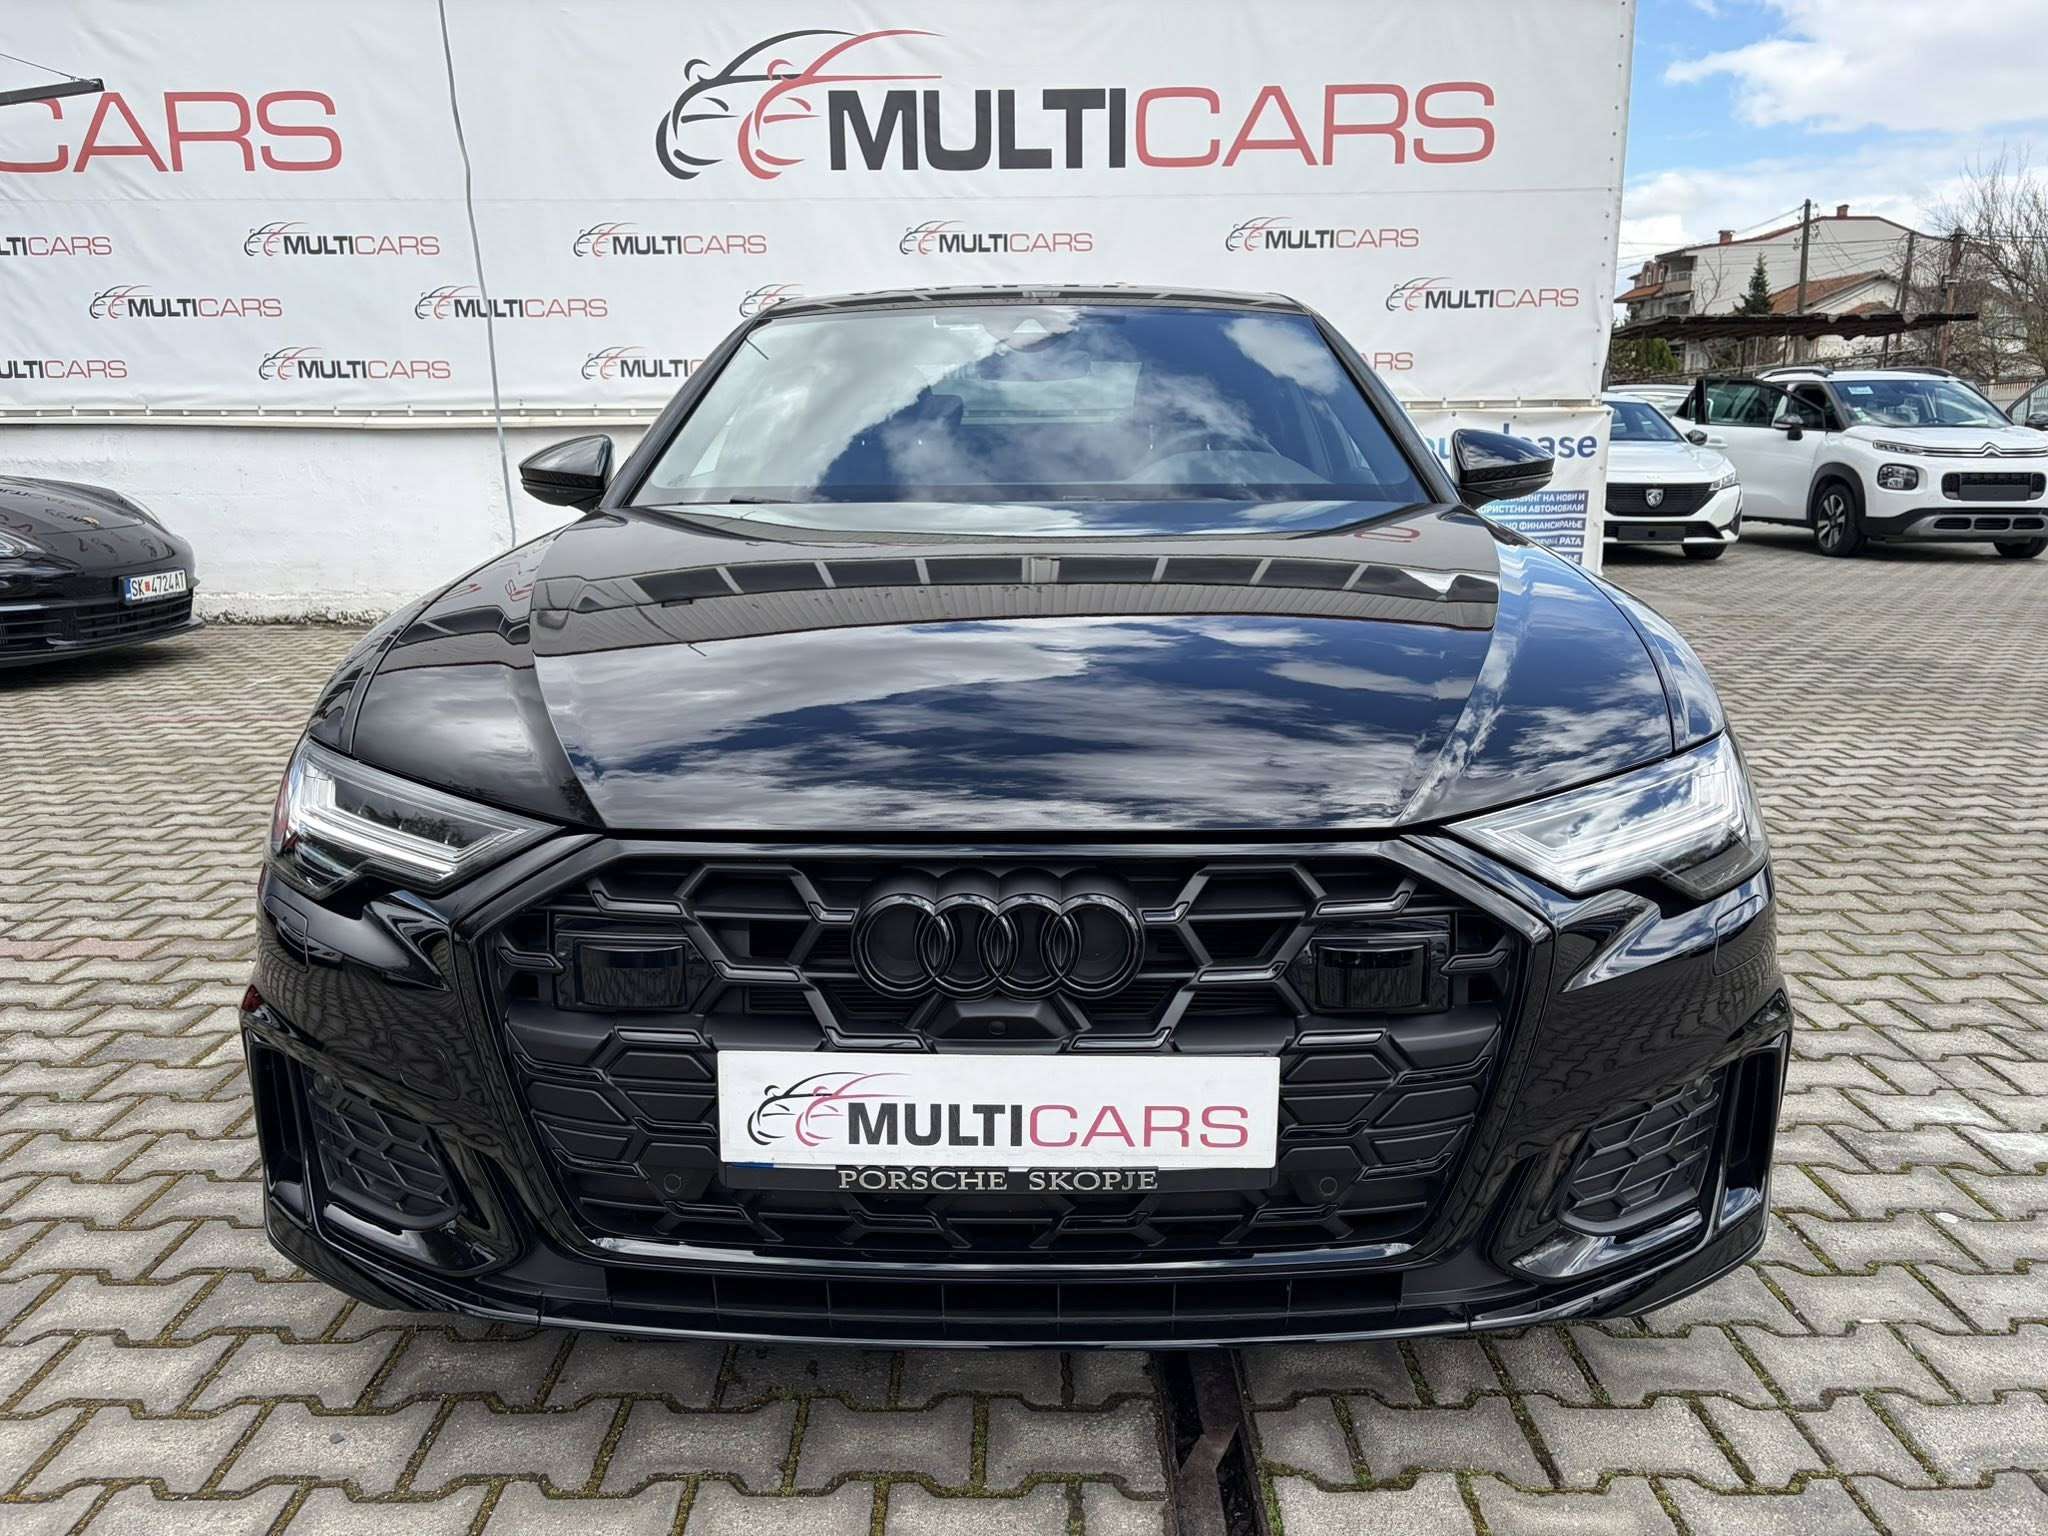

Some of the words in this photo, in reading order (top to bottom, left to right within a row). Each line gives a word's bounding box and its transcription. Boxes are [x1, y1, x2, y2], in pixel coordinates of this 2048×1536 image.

[828, 81, 1496, 172] MULTICARS
[283, 235, 440, 256] MULTICARS
[612, 234, 767, 256] MULTICARS
[938, 232, 1093, 253] MULTICARS
[1264, 229, 1419, 249] MULTICARS
[127, 298, 283, 318] MULTICARS
[453, 298, 608, 318] MULTICARS
[1424, 288, 1579, 309] MULTICARS
[297, 359, 451, 380] MULTICARS
[1543, 493, 1554, 502] НА
[1578, 492, 1585, 501] И
[1559, 536, 1581, 545] РАТА
[131, 578, 145, 597] SK
[847, 1102, 1249, 1149] MULTICARS
[838, 1169, 1008, 1191] PORSCHE
[1028, 1170, 1160, 1191] SKOPJE
